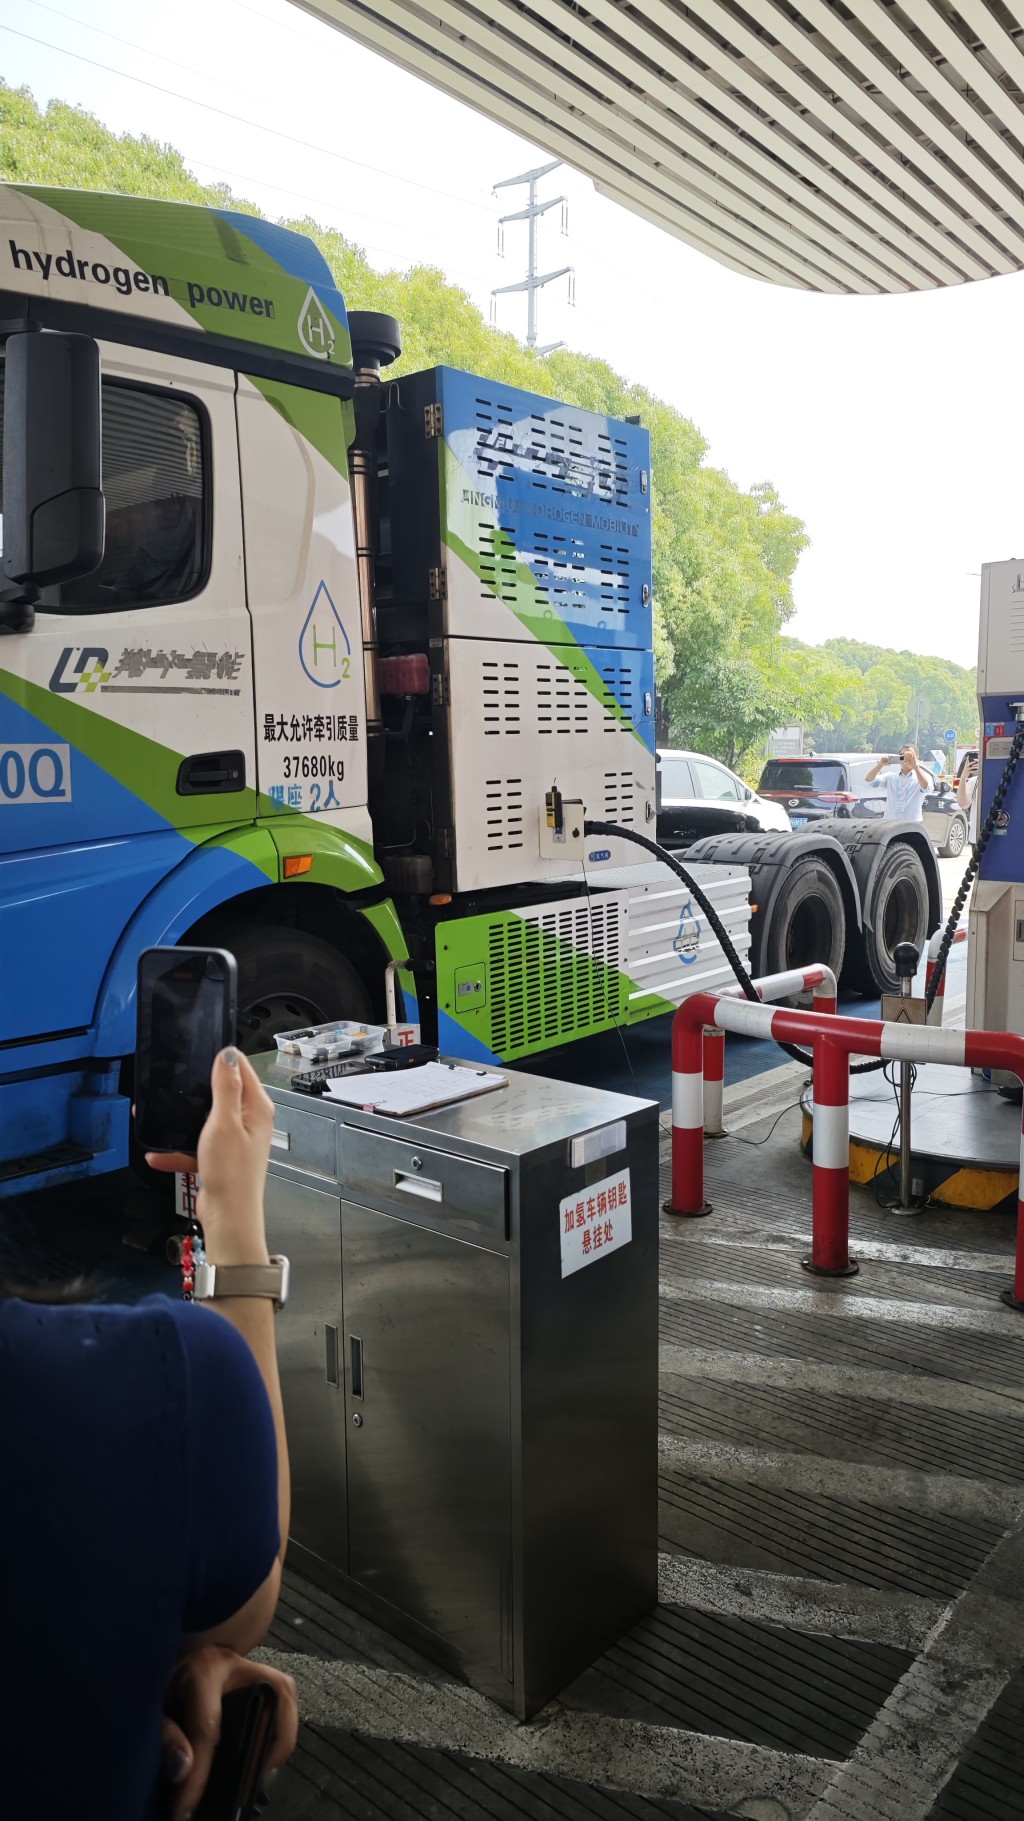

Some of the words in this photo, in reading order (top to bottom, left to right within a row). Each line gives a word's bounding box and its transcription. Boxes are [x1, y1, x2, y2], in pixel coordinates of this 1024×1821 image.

[9, 239, 170, 296] hydrogen
[187, 279, 276, 320] power
[591, 514, 640, 537] MOBILITY
[263, 713, 359, 742] 最大允许牵引质量
[283, 755, 345, 781] 37680kg
[564, 1181, 628, 1234] 加氢车辆钥匙
[581, 1219, 614, 1255] 悬挂处
